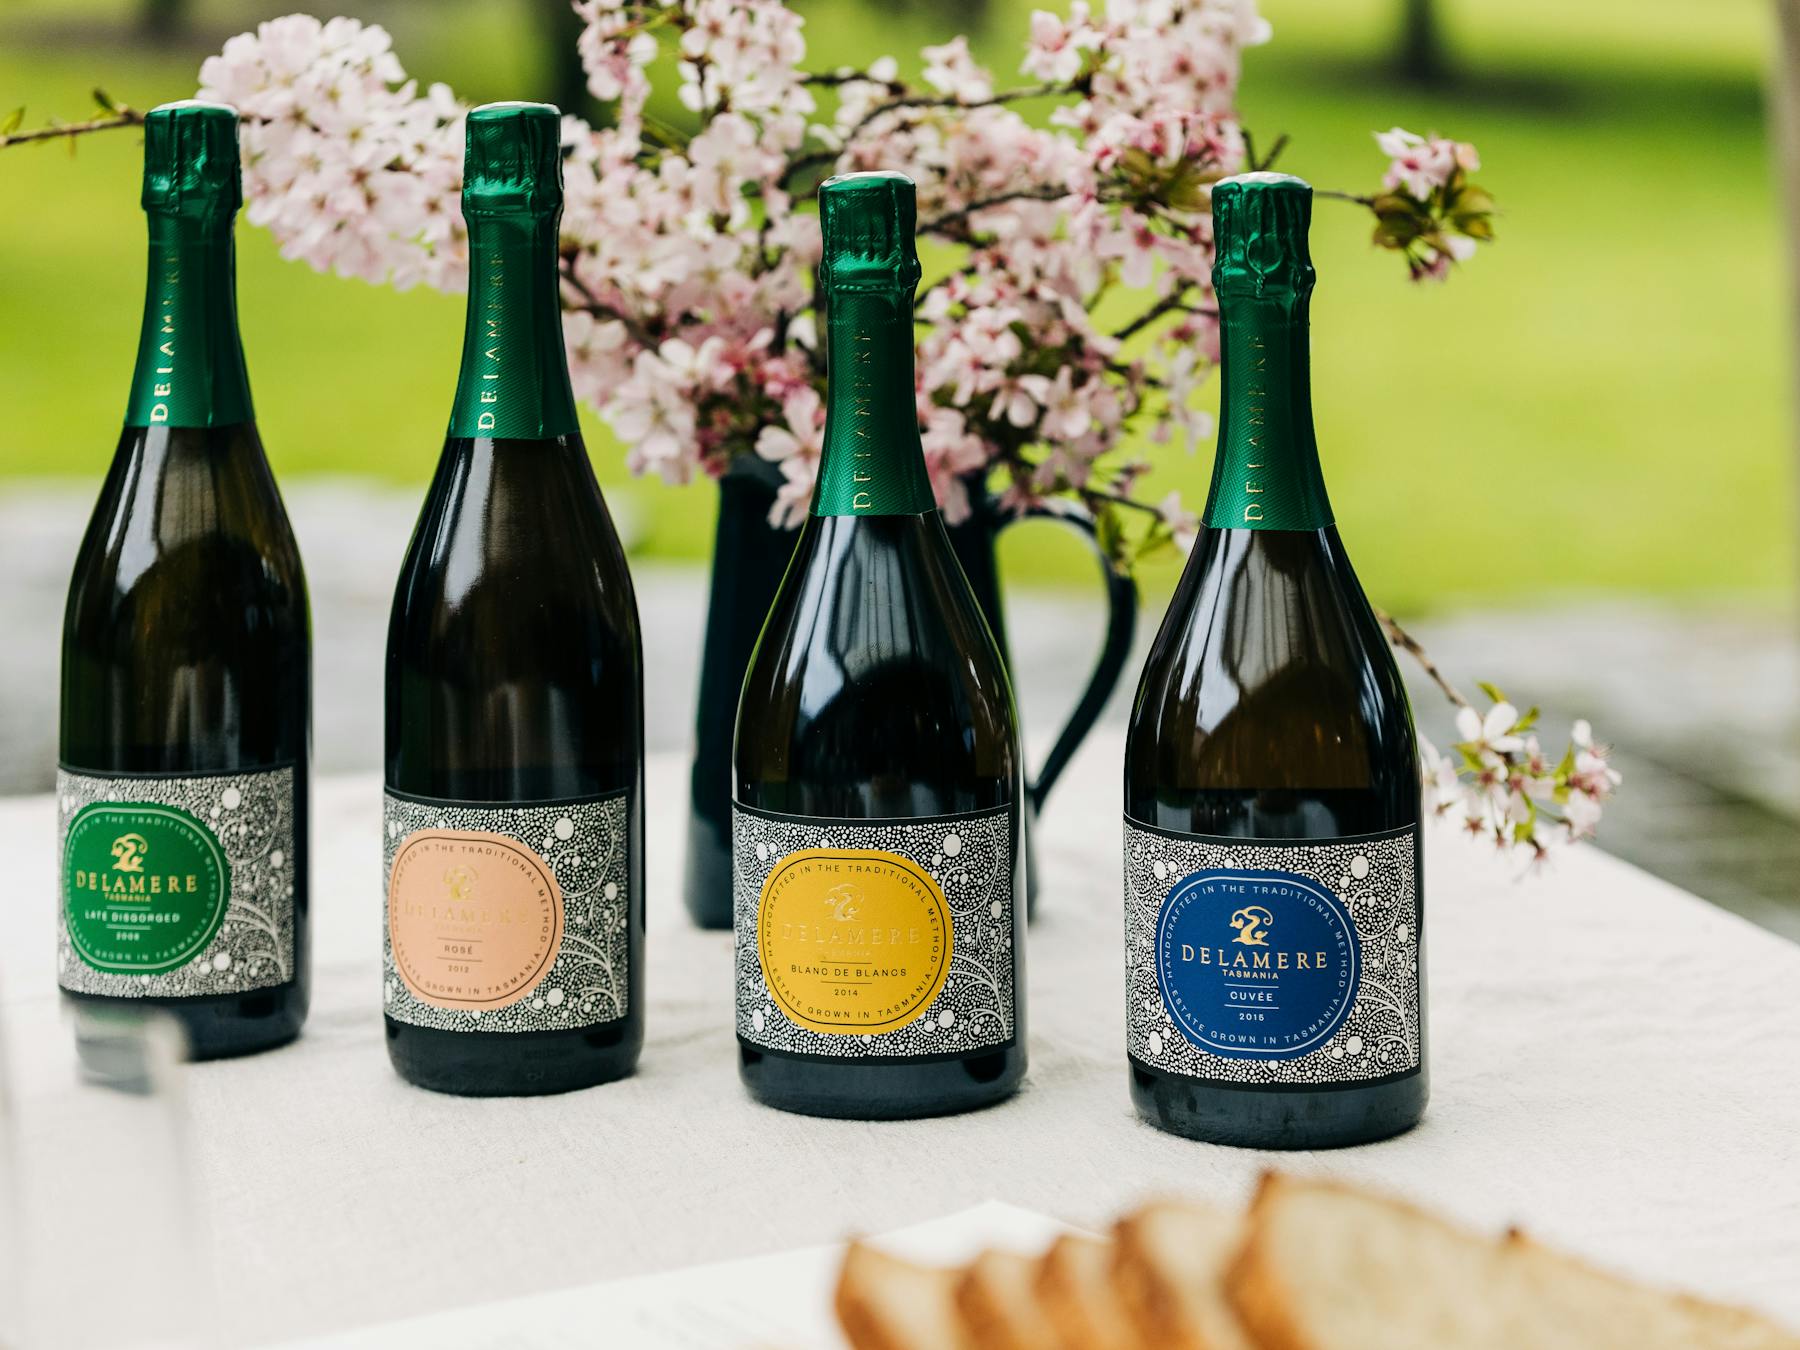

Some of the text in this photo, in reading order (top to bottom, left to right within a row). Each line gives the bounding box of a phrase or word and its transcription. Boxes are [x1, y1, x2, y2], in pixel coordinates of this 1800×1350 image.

[76, 869, 198, 894] DELAMERE
[435, 843, 455, 853] THE
[461, 845, 538, 884] TRADITIONAL
[537, 888, 550, 943] METHOD
[84, 909, 181, 923] LATE DISGORGED
[765, 864, 940, 963] HANDCRAFTED IN THE TRADITIONAL METHOD
[781, 923, 921, 945] DELAMERE
[1164, 884, 1348, 987] HANDCRAFTED IN THE TRADITIONAL METHOD
[444, 944, 473, 955] ROSÉ
[1181, 944, 1328, 970] DELAMERE
[425, 981, 463, 994] GROWN
[467, 987, 480, 995] IN
[487, 951, 541, 995] TASMANIA
[791, 964, 907, 977] BLANC DE BLANCS
[1222, 969, 1279, 980] TASMANIA
[772, 967, 932, 1019] ESTATE GROWN IN TASMANIA
[834, 988, 859, 997] 2014
[1230, 990, 1273, 1002] CUVÉE
[1171, 989, 1340, 1044] ESTATE GROWN IN TASMANIA
